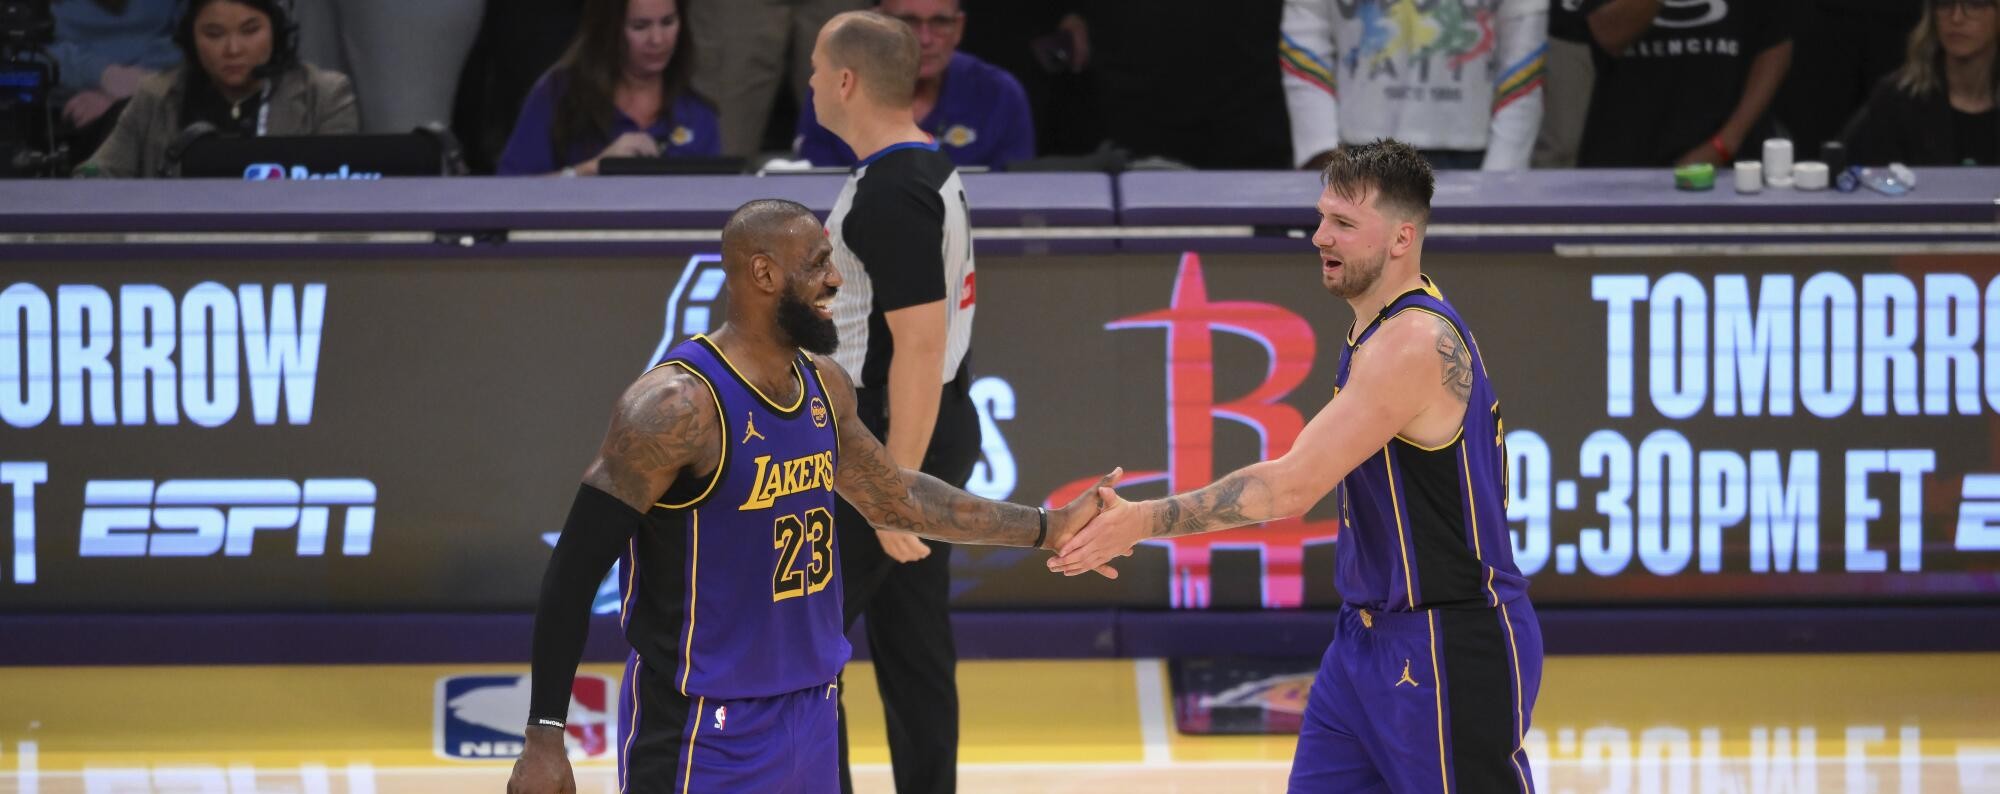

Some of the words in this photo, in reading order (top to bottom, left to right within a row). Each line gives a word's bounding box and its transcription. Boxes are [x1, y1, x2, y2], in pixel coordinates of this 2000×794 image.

[1591, 271, 2000, 419] TOMORR
[79, 478, 377, 557] ESPN
[738, 450, 834, 511] LAKERS
[1504, 429, 1819, 577] 9:30PM
[1845, 449, 1937, 572] ET
[772, 506, 834, 603] 23
[459, 741, 526, 757] NB
